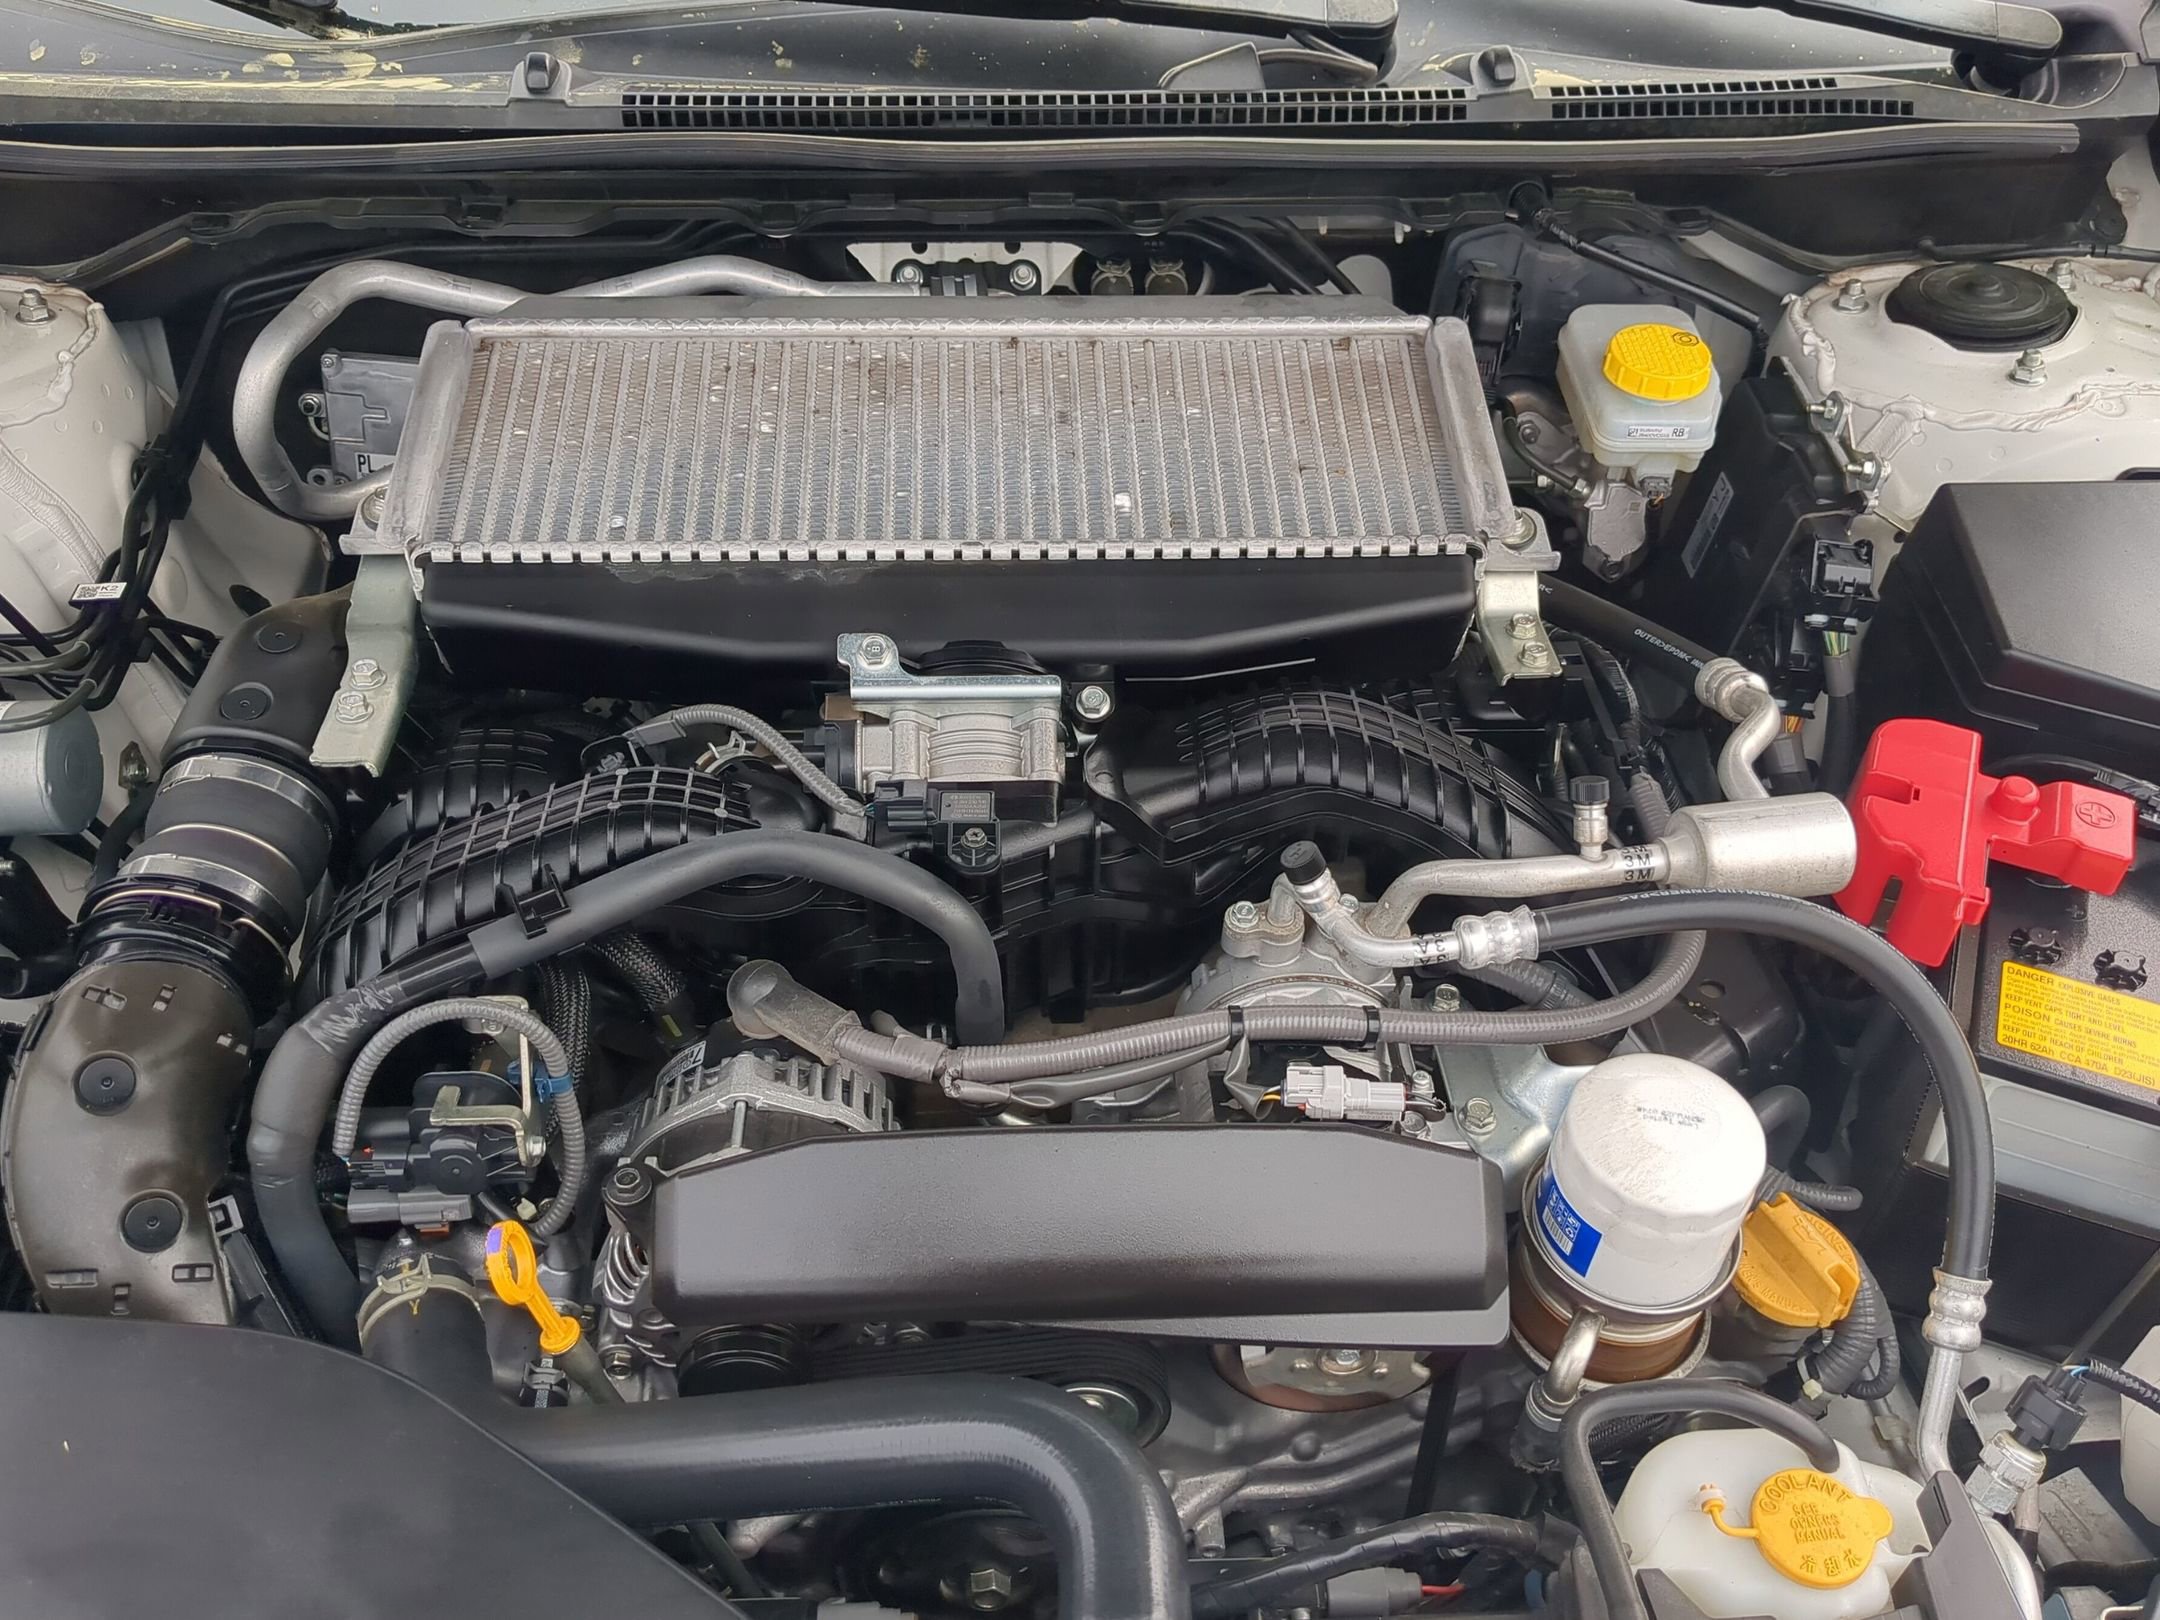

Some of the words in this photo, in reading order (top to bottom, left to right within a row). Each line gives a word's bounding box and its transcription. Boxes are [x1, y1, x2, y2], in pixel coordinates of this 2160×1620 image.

[2007, 966, 2055, 986] DANGER
[2058, 981, 2095, 999] EXPLOSIVE
[2098, 991, 2121, 1006] GASES
[2004, 1003, 2051, 1022] POISON
[2054, 1018, 2082, 1034] CAUSES
[2005, 992, 2023, 1004] KEEP
[2024, 997, 2042, 1009] VENT
[2044, 1002, 2063, 1016] CAPS
[2088, 1014, 2103, 1027] AND
[2104, 1019, 2126, 1034] LEVEL
[2002, 1023, 2021, 1035] KEEP
[2022, 1028, 2037, 1039] OUT
[2038, 1032, 2048, 1042] OF
[2050, 1034, 2074, 1050] REACH
[2075, 1042, 2086, 1054] OF
[2087, 1045, 2124, 1065] CHILDREN
[2002, 1033, 2028, 1049] 20HR
[2030, 1041, 2055, 1057] 62Ah
[2059, 1051, 2082, 1065] CCA
[2114, 1066, 2156, 1087] D23(JIS)
[1759, 1473, 1853, 1515] COOLANT
[1792, 1502, 1818, 1517] SEE
[1794, 1527, 1846, 1545] MANUAL
